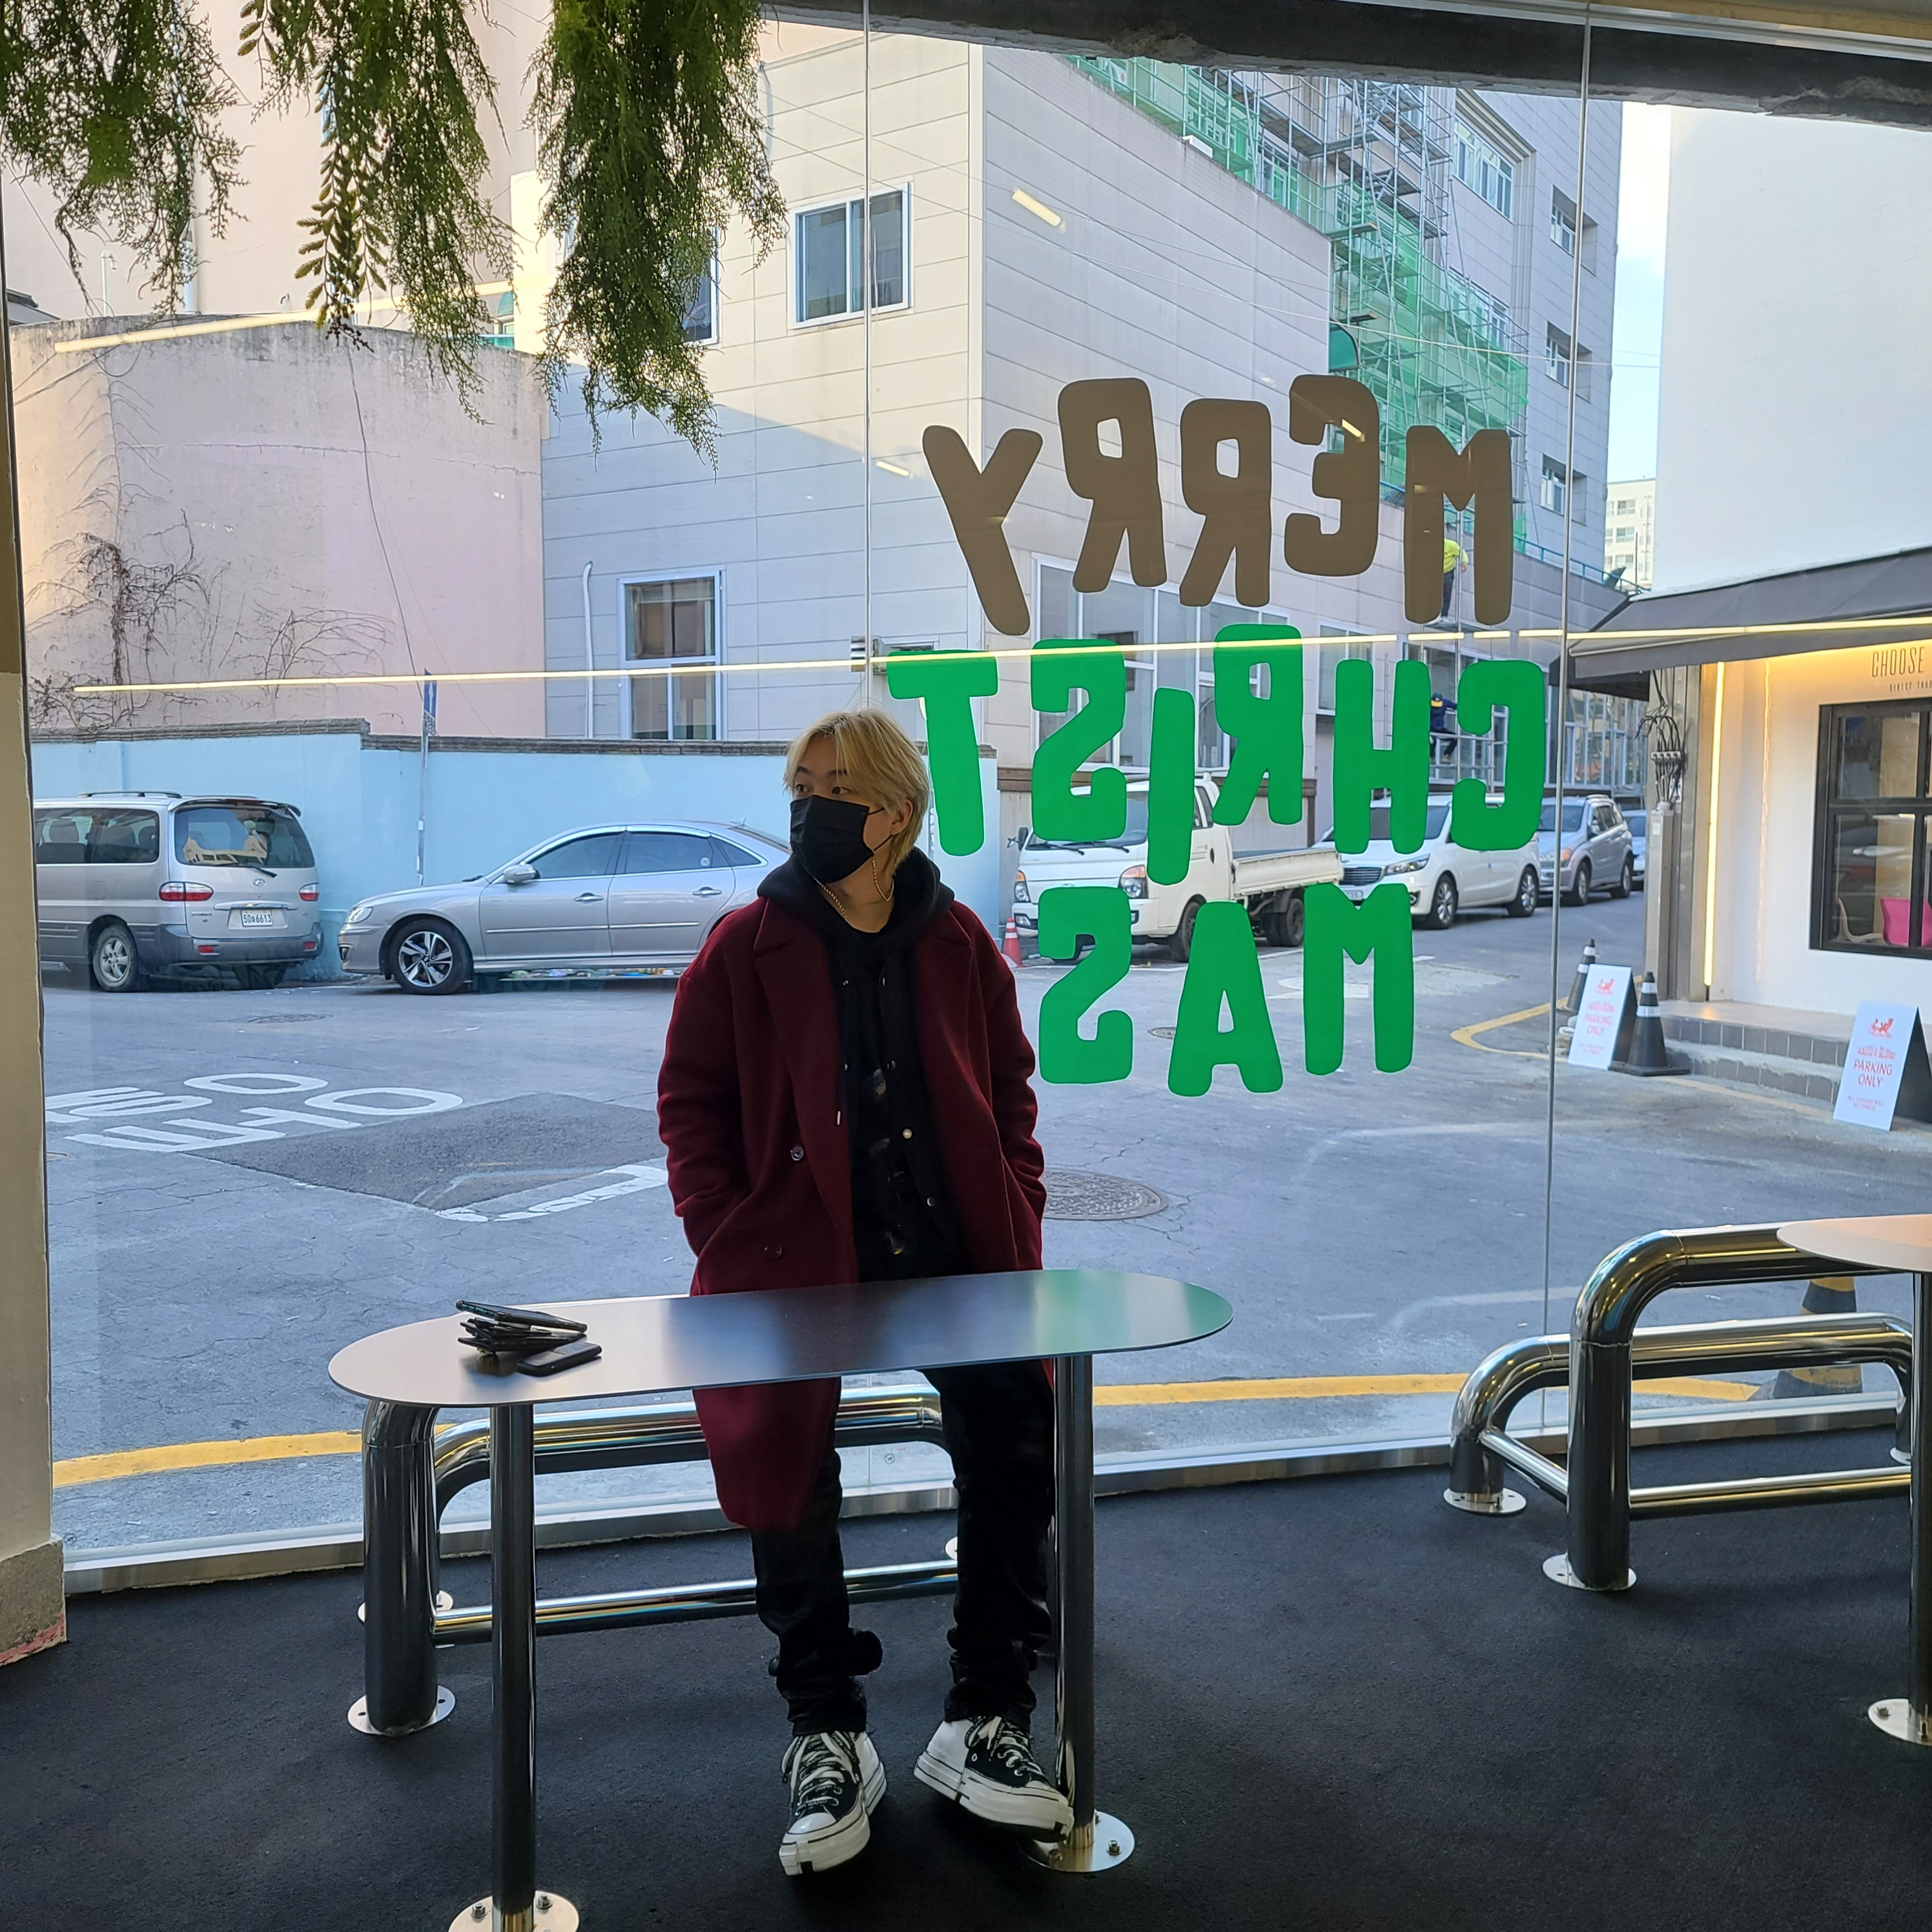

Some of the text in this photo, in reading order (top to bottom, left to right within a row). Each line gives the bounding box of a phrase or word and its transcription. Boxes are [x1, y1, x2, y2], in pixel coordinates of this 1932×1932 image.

[1872, 646, 1925, 677] CHOOSE
[1853, 1059, 1893, 1075] PARKING
[1858, 1073, 1883, 1088] ONLY
